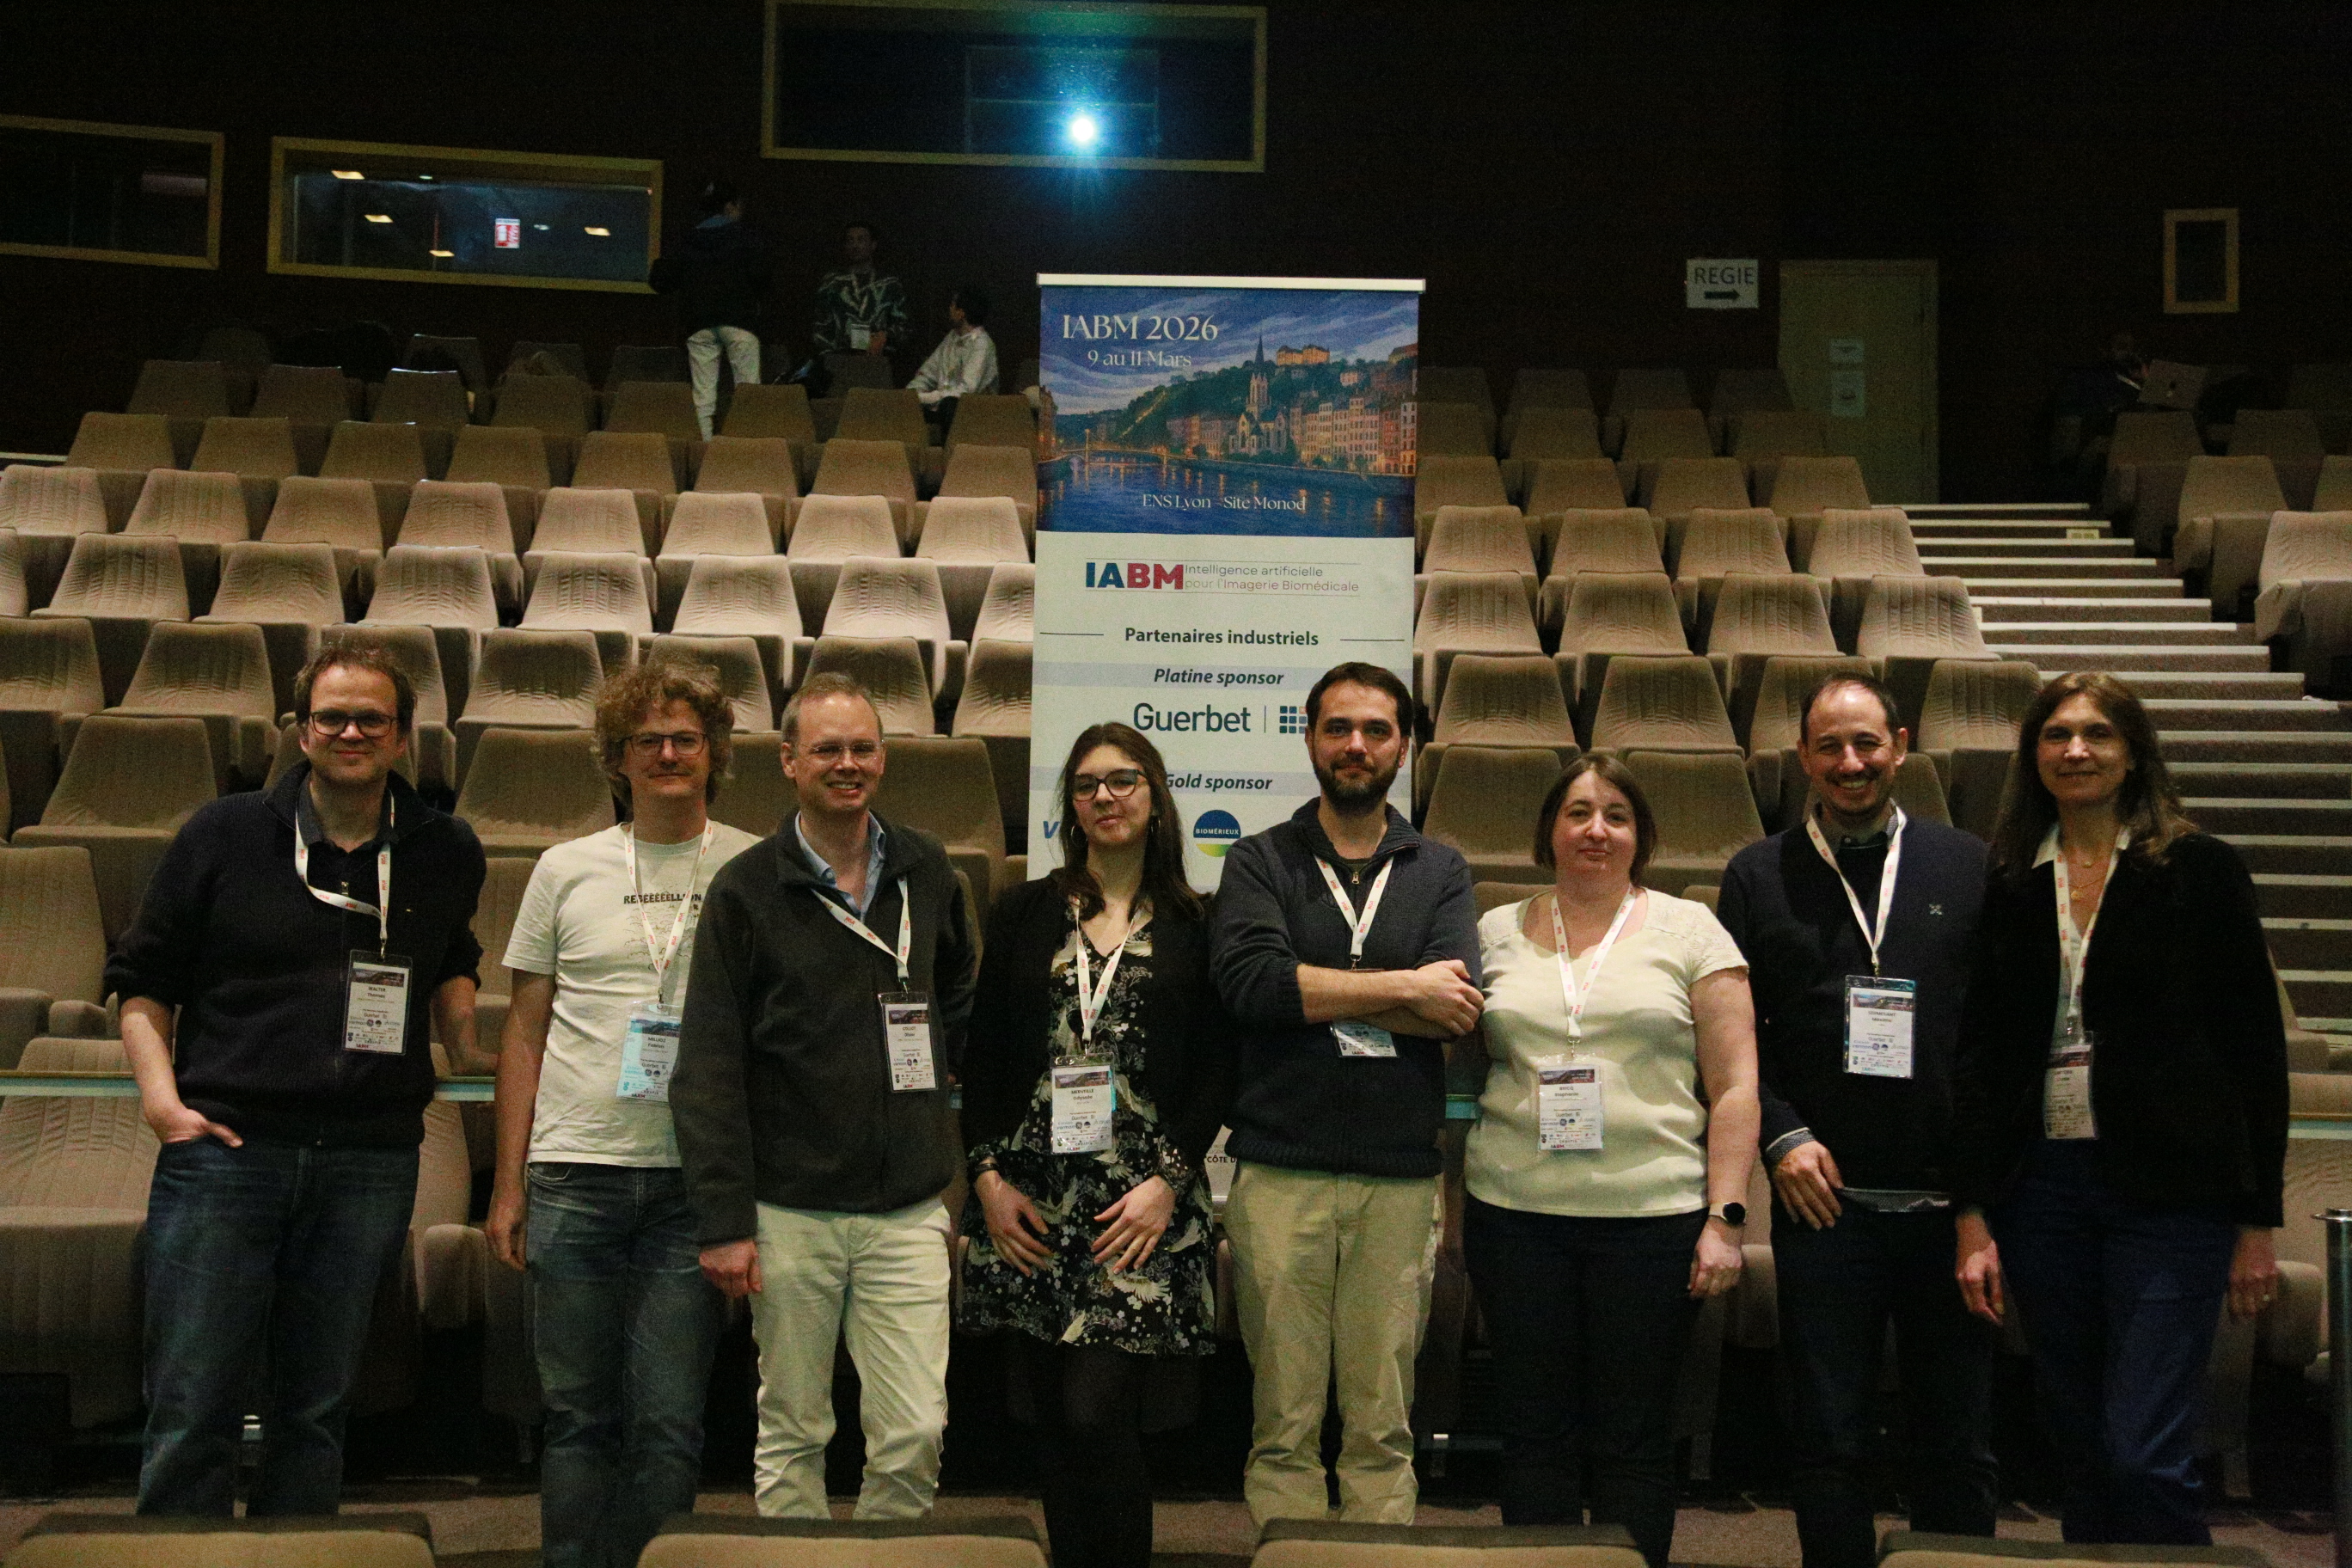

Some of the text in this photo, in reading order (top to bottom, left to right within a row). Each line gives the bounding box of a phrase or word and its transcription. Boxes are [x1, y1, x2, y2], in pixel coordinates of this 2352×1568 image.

[1694, 266, 1755, 285] REGIE
[1063, 314, 1219, 341] IABM 2026
[1087, 349, 1099, 367] 9
[1103, 353, 1125, 366] au
[1148, 350, 1192, 367] Mars
[1142, 494, 1173, 508] ENS
[1175, 495, 1211, 511] Lyon
[1223, 496, 1251, 510] Site
[1253, 496, 1307, 511] Monod
[1086, 562, 1185, 590] IABM
[1185, 564, 1324, 577] Intelligence artificielle
[1185, 579, 1213, 590] pour
[1282, 580, 1360, 591] Biomédicale
[1125, 628, 1319, 646] Partenaires industriels
[1154, 668, 1284, 688] Platine sponsor
[1133, 702, 1252, 732] Guerbet
[1167, 774, 1273, 793] Gold sponsor
[1195, 827, 1240, 836] BIOMÉRIEUX
[1206, 1155, 1228, 1163] CÔTE
